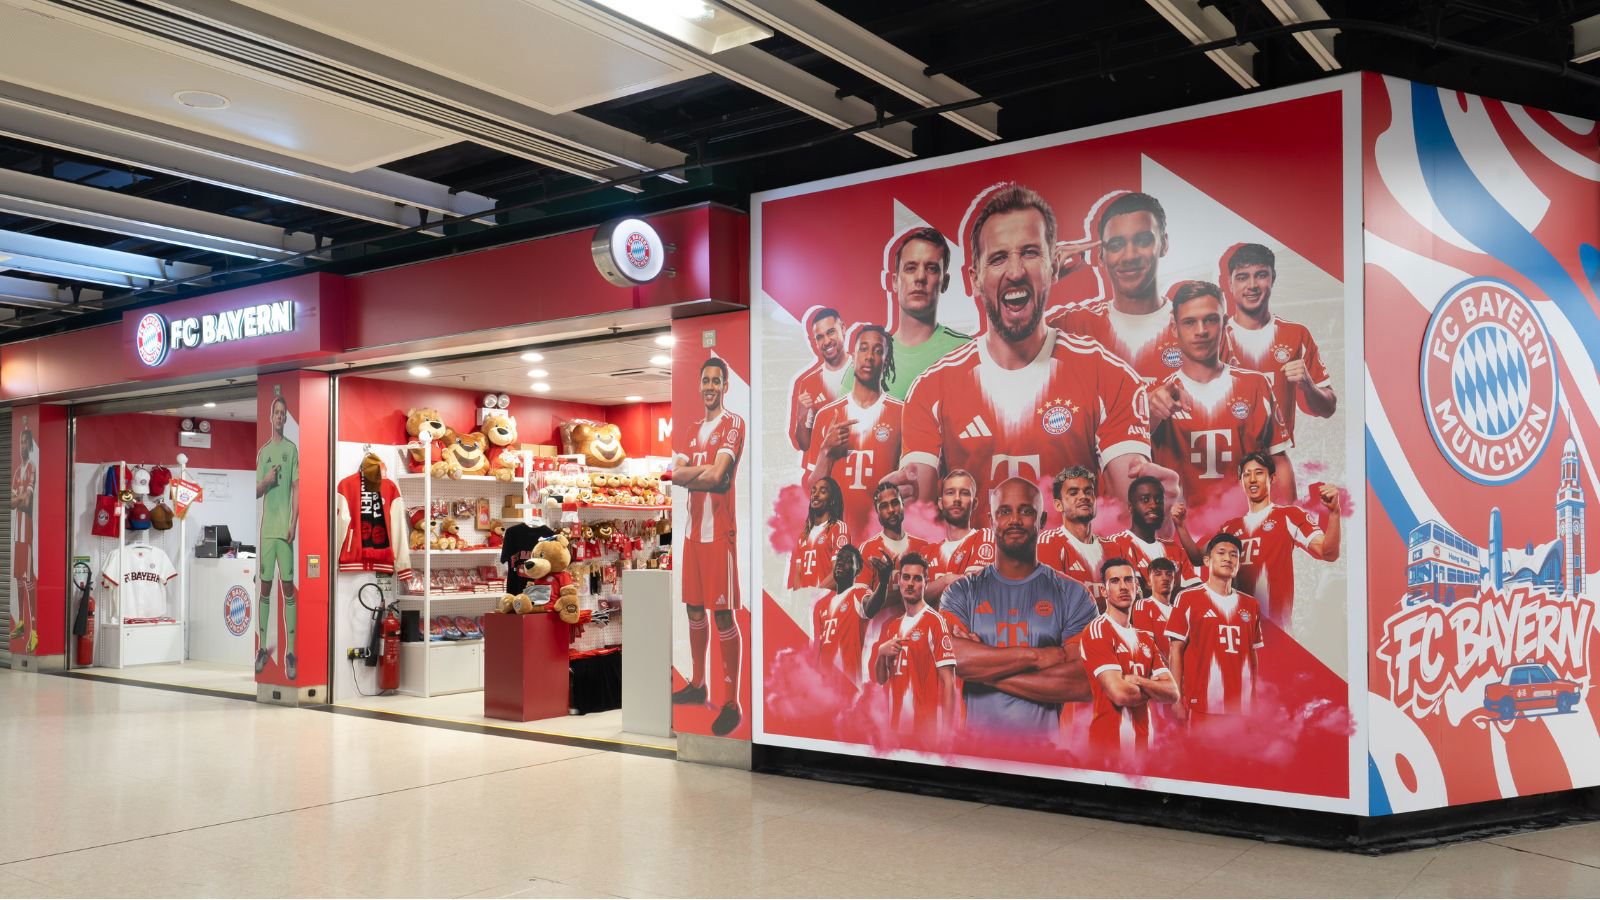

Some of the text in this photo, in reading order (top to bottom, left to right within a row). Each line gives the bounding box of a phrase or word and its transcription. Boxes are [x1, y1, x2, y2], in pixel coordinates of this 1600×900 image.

[171, 300, 294, 349] FC BAYERN
[1432, 292, 1547, 369] FC BAYERN
[1190, 428, 1232, 480] T
[1435, 398, 1547, 471] MÜNCHEN
[845, 449, 874, 490] T
[1218, 624, 1241, 654] T
[1393, 593, 1591, 696] FC BAYERN
